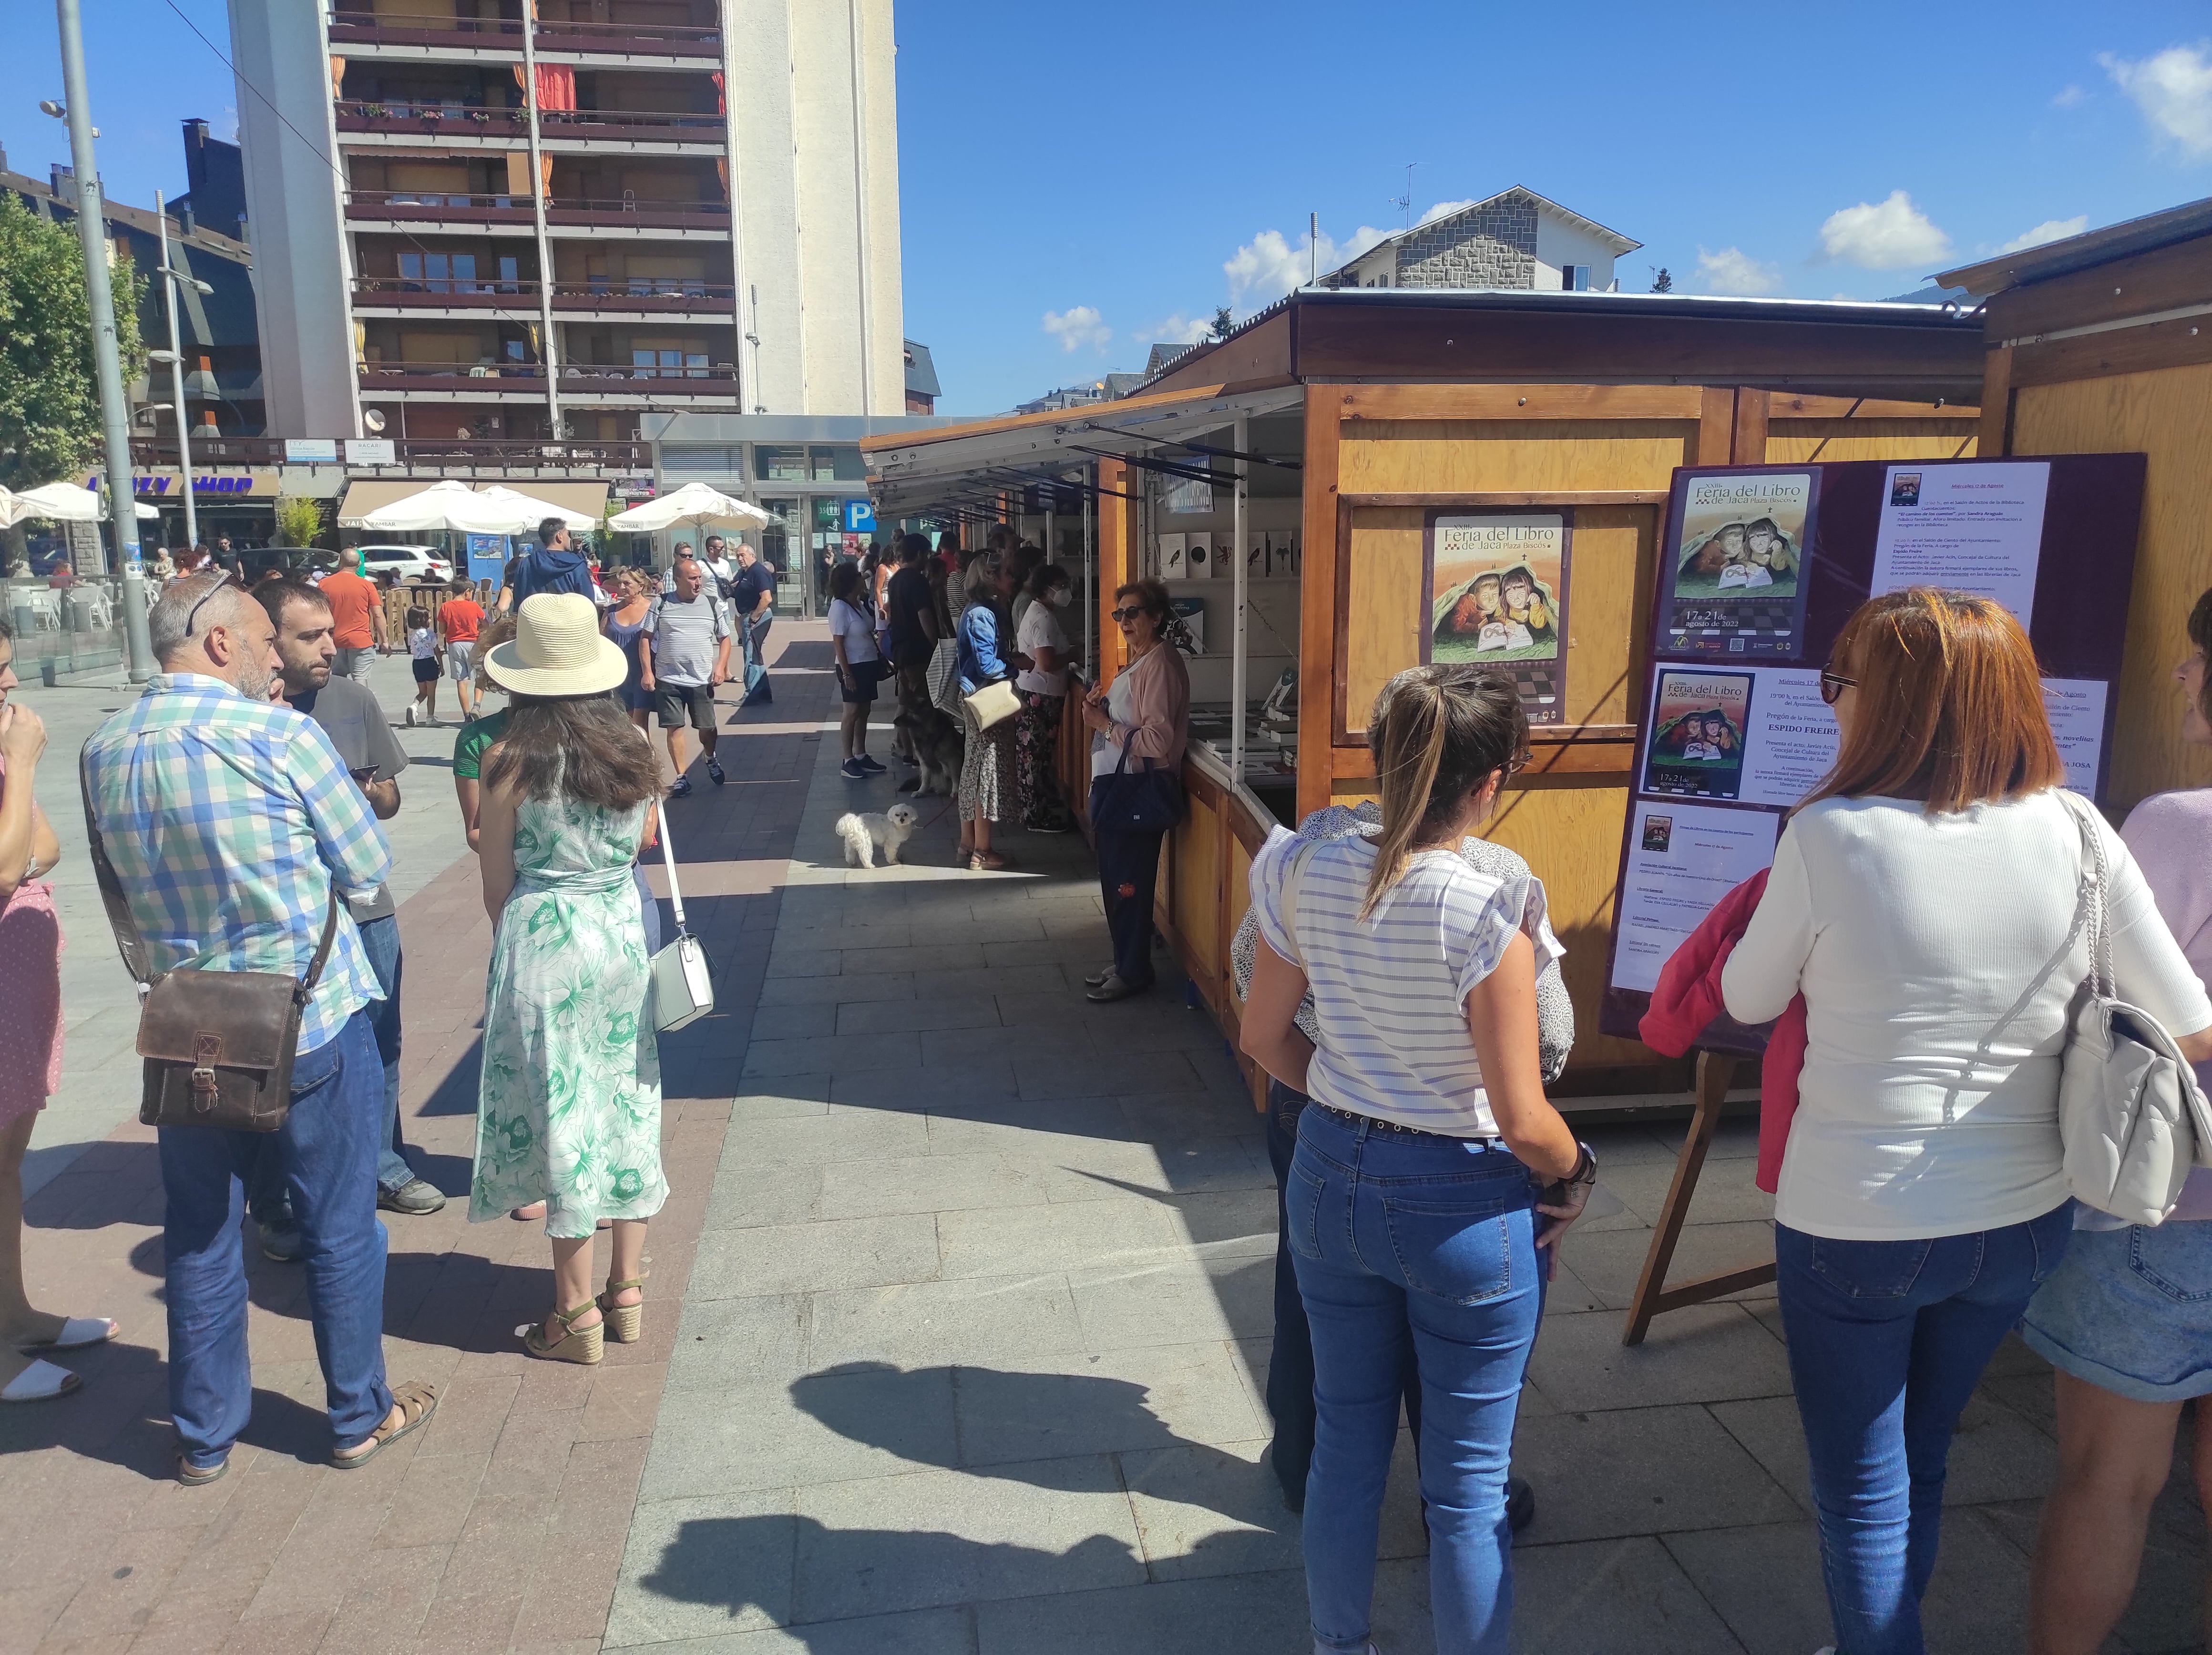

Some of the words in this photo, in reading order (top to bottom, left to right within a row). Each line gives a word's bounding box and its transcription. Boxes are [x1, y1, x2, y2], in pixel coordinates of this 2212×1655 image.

[1697, 488, 1730, 498] Feria
[1736, 484, 1758, 497] del
[1763, 484, 1801, 496] Libro
[1711, 496, 1724, 504] de
[851, 503, 871, 528] P
[1445, 529, 1481, 542] Feria
[1487, 526, 1509, 541] del
[1516, 526, 1554, 541] Libro
[1462, 540, 1475, 550] de
[1478, 541, 1501, 550] Jaca
[1669, 684, 1692, 693] Feria
[1696, 684, 1712, 694] del
[1715, 685, 1741, 696] Libro
[1766, 712, 1789, 720] Pregón
[1768, 724, 1802, 733] ESPIDO
[1804, 726, 1839, 735] FREIRE
[1773, 753, 1808, 761] Ayuntamiento
